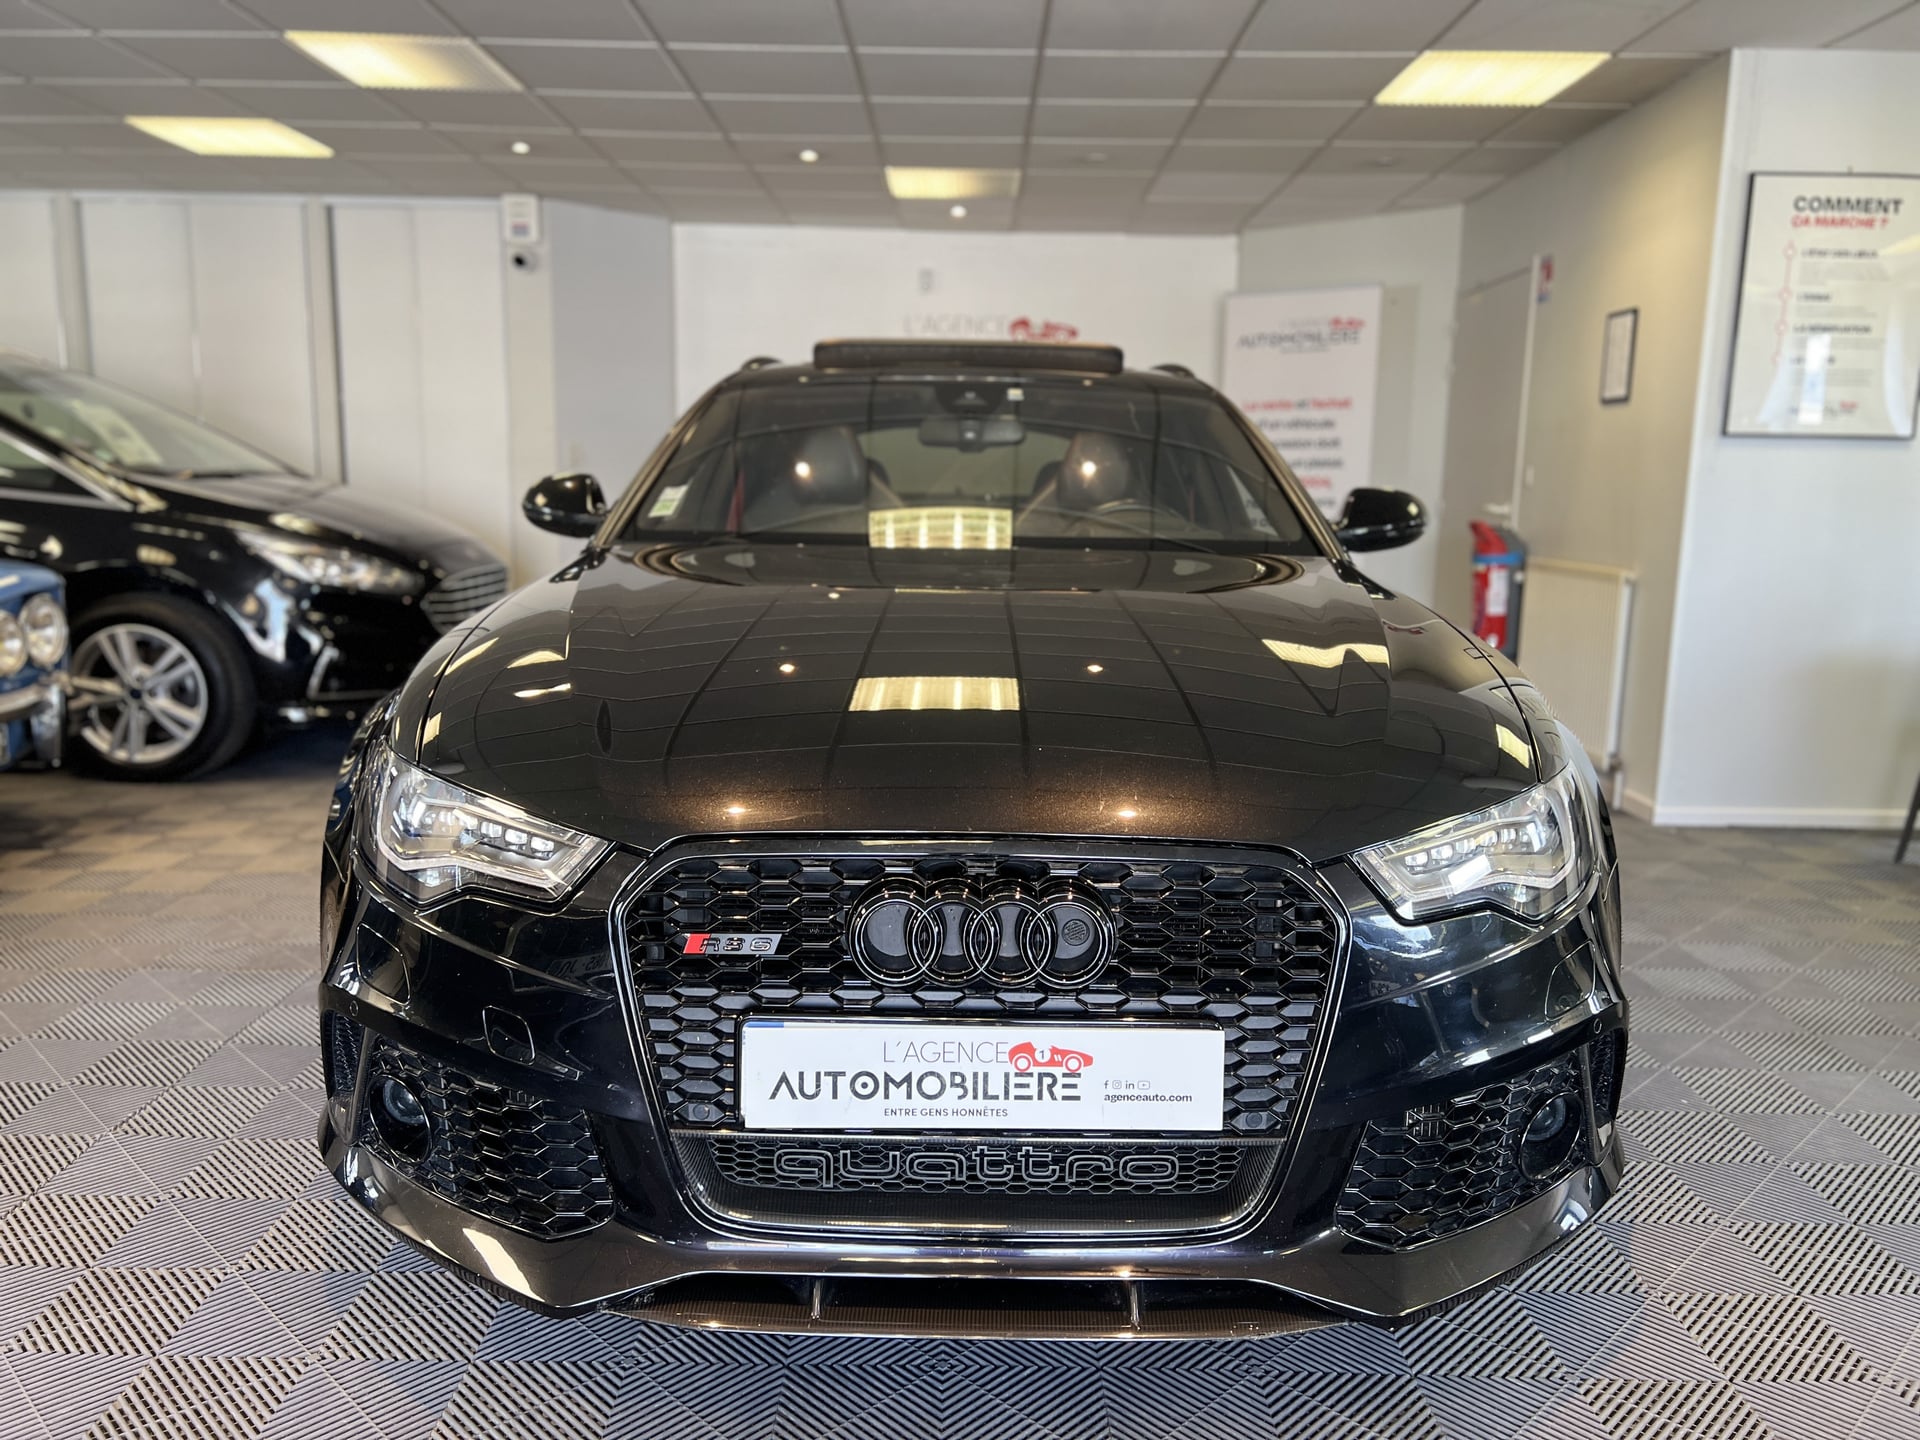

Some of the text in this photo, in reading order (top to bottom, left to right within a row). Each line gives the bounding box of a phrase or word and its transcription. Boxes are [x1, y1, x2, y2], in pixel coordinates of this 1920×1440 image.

[1793, 195, 1903, 214] COMMENT
[1814, 216, 1876, 229] MARCHE
[883, 1040, 1009, 1064] L'AGENCE
[1103, 1092, 1193, 1104] agenceauto.com
[884, 1106, 1009, 1117] ENTRE GENS HONNÊTES
[773, 1145, 1179, 1188] quattro
